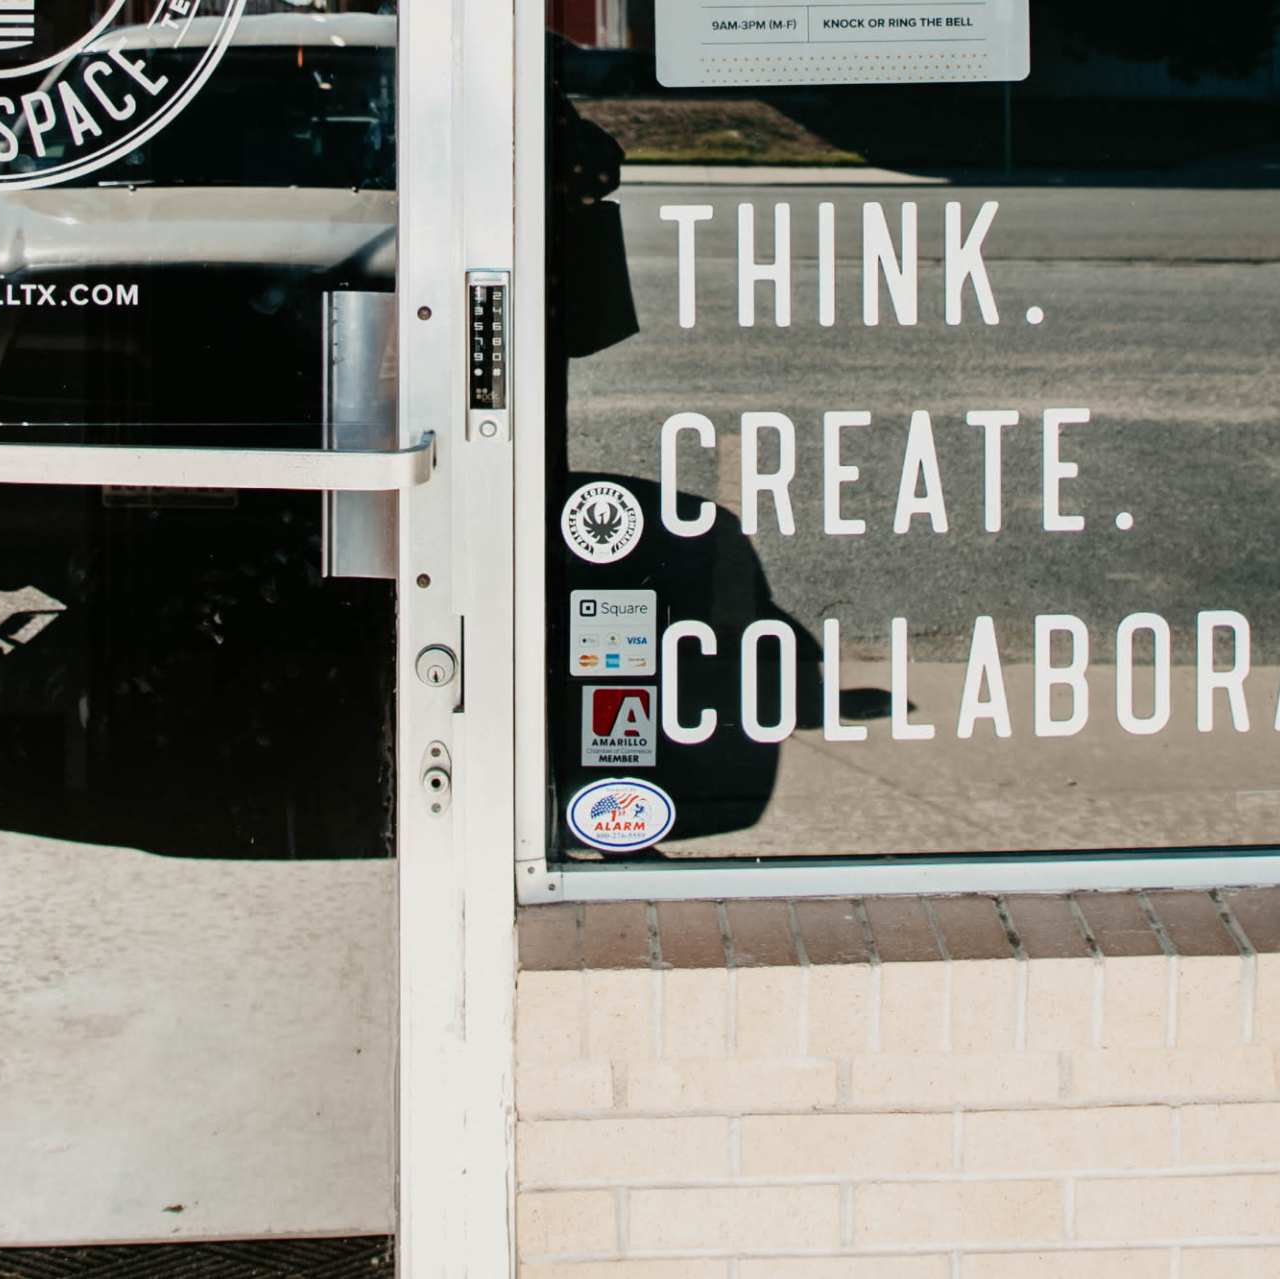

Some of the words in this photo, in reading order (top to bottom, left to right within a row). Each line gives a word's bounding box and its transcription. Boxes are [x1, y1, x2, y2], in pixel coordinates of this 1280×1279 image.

[711, 19, 766, 31] 9AM-3PM
[768, 18, 798, 30] (M-F)
[823, 18, 865, 29] KNOCK
[868, 18, 885, 28] OR
[888, 18, 917, 28] RING
[920, 17, 942, 27] THE
[945, 16, 973, 27] BELL
[659, 201, 1045, 329] THINK.
[660, 407, 1134, 537] CREATE.
[601, 602, 648, 616] Square
[627, 637, 647, 645] VISA
[592, 738, 648, 746] AMARILLO
[599, 754, 640, 763] MEMBER
[595, 821, 645, 831] ALARM
